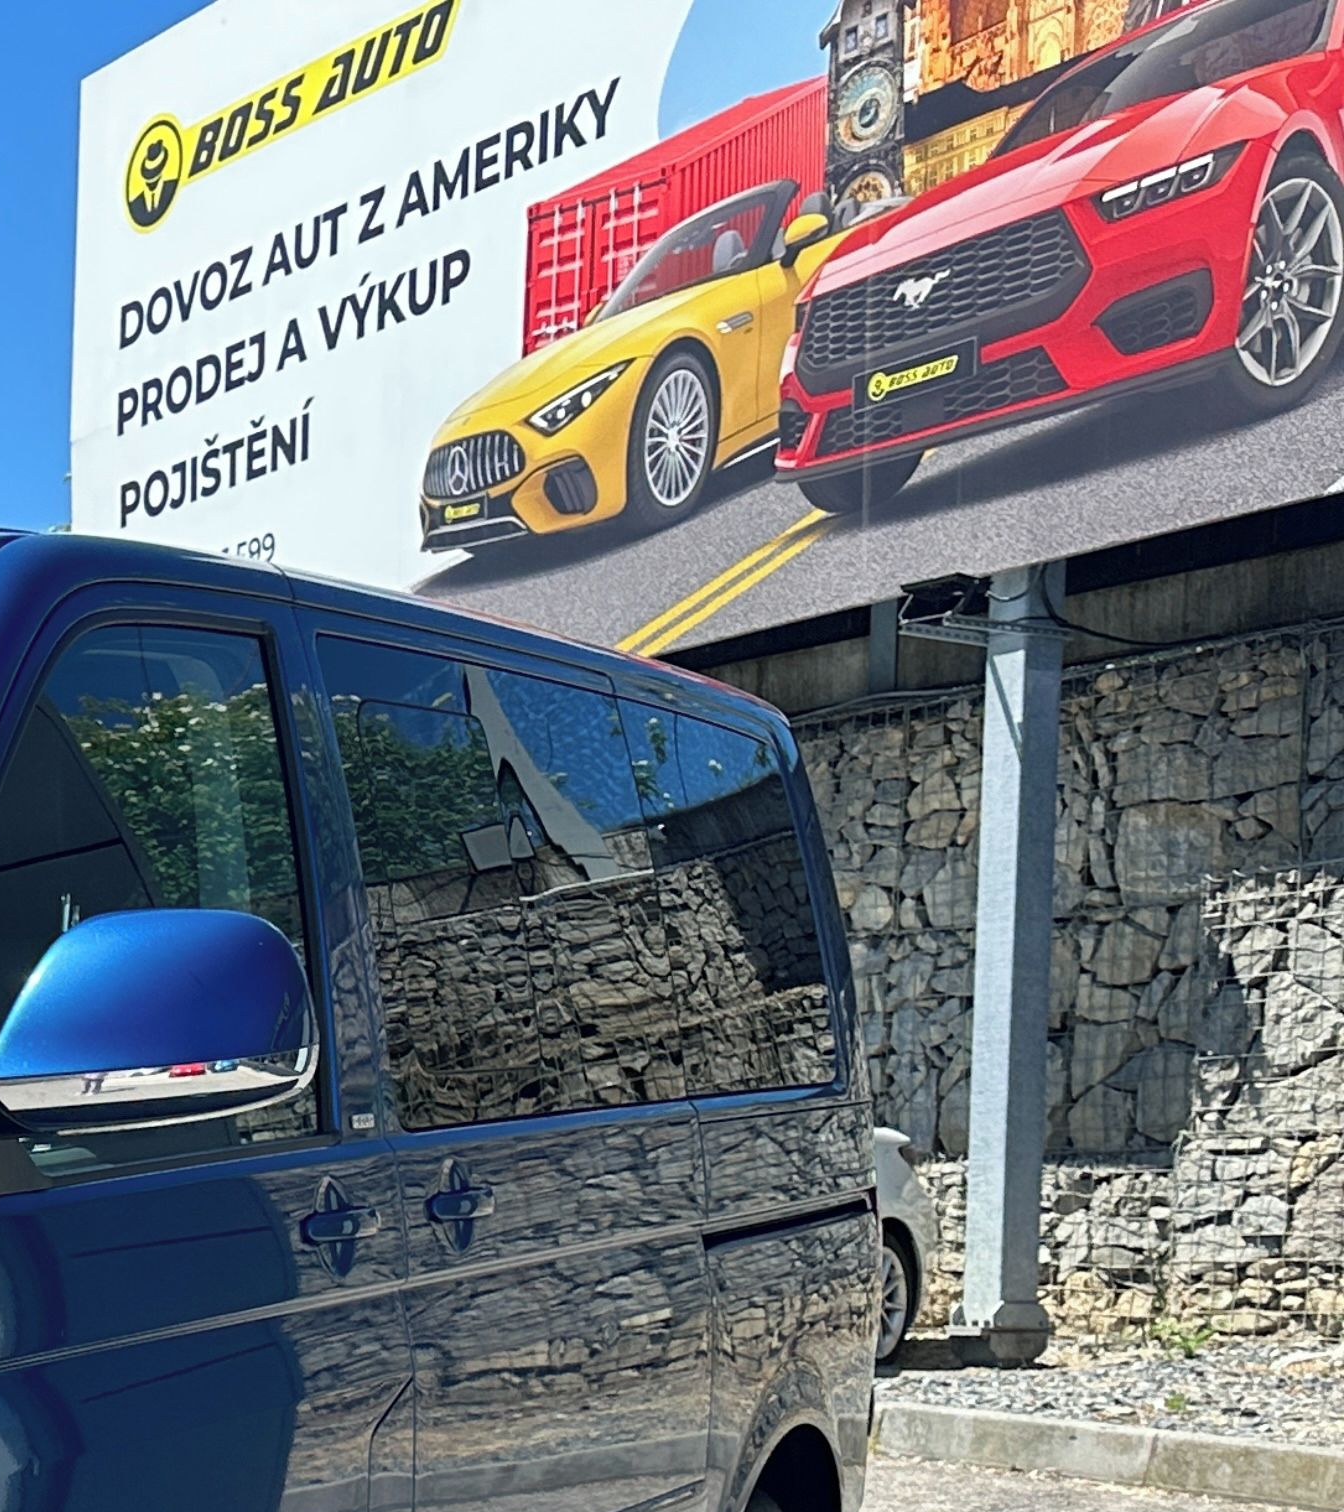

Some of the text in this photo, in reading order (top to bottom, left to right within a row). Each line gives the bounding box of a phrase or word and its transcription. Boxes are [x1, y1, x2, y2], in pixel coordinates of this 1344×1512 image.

[187, 0, 455, 179] BOSS AUTO
[119, 77, 621, 350] DOVOZ AUT Z AMERIKY
[117, 249, 471, 437] PRODEJ A VÝKUP
[120, 397, 313, 529] POJIŠTĚNÍ
